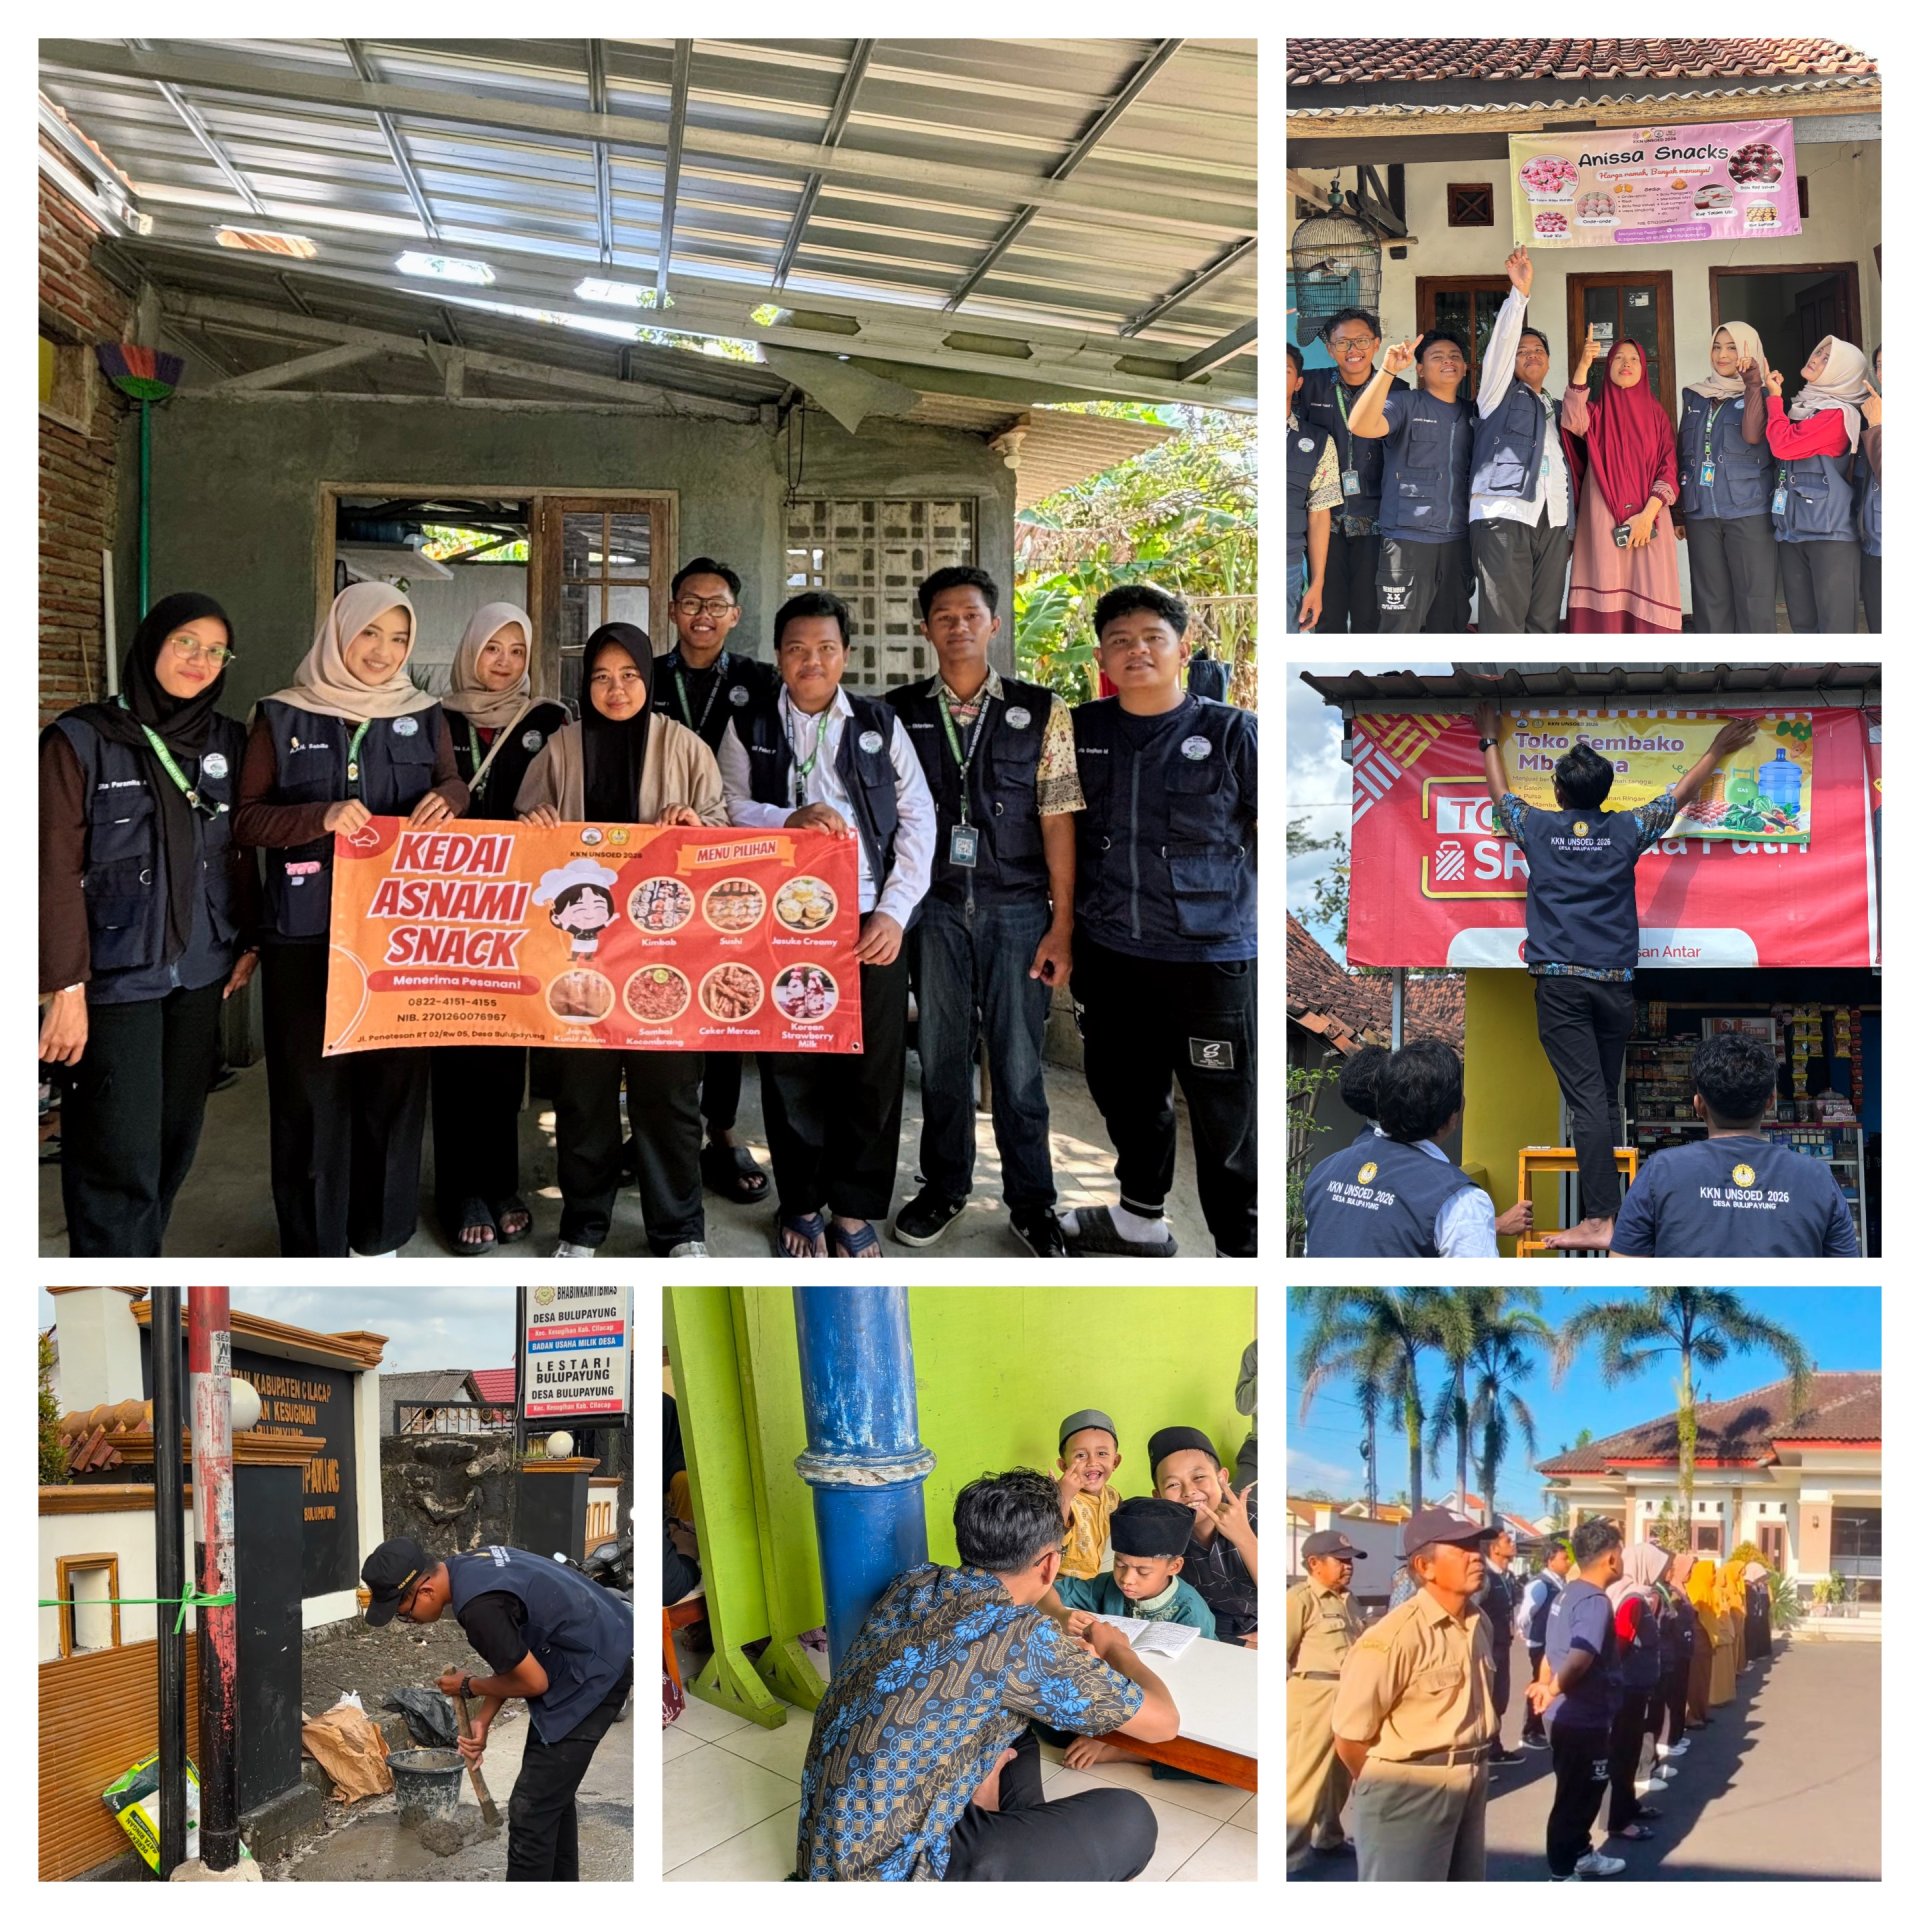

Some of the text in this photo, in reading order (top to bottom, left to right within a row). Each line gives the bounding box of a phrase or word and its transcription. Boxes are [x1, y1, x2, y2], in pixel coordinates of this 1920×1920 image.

[1578, 143, 1729, 168] Anissa Snacks
[1599, 172, 1623, 181] Harga
[1650, 168, 1678, 178] Banyak
[1515, 732, 1685, 752] Toko Sembako
[1512, 775, 1538, 783] Menjual
[1737, 786, 1749, 794] GAS
[1450, 800, 1493, 832] TO
[1550, 837, 1611, 846] KKN UNSOED 2026
[392, 831, 515, 876] KEDAI
[589, 851, 622, 859] UNSOED
[697, 840, 777, 862] MENU PILIHAN
[367, 878, 532, 925] ASNAMI
[383, 924, 530, 970] SNACK
[641, 938, 677, 946] Kimbab
[719, 937, 743, 945] Sushi
[771, 937, 838, 947] Jasuke Creamy
[1662, 945, 1702, 958] Antar
[393, 975, 521, 989] Menerima Pesanan!
[408, 998, 497, 1007] 0822-4151-4155
[397, 1013, 507, 1023] NIB. 2701260076967
[639, 1027, 673, 1035] Sambal
[699, 1027, 760, 1035] Ceker Mercon
[791, 1022, 824, 1031] Korean
[457, 1030, 470, 1038] 05,
[495, 1030, 545, 1041] Bulupayung
[626, 1037, 684, 1047] Kecombrang
[782, 1031, 834, 1041] Strawberry
[798, 1040, 817, 1048] Milk
[1326, 1180, 1396, 1206] KKN UNSOED 2026
[1700, 1187, 1790, 1203] KKN UNSOED 2026
[1331, 1194, 1380, 1210] DESA BULUPAYUNG
[1732, 1201, 1776, 1209] BULUPAYUNG
[533, 1306, 617, 1324] DESA BULUPAYUNG
[535, 1325, 614, 1337] Kec. Kesugihan Kab. Cilacap
[532, 1336, 616, 1351] BADAN USAHA MILIK DESA
[536, 1369, 610, 1384] BULUPAYUNG
[253, 1372, 301, 1399] KABUPATEN
[302, 1381, 331, 1403] CILACAP
[532, 1386, 614, 1400] DESA BULUPAYUNG
[274, 1401, 316, 1425] KESUGIHAN
[533, 1401, 611, 1412] Kec. Kesugihan Kab. Cilacap
[303, 1458, 339, 1494] PAYUNG
[304, 1506, 336, 1522] BULUPAYUNG
